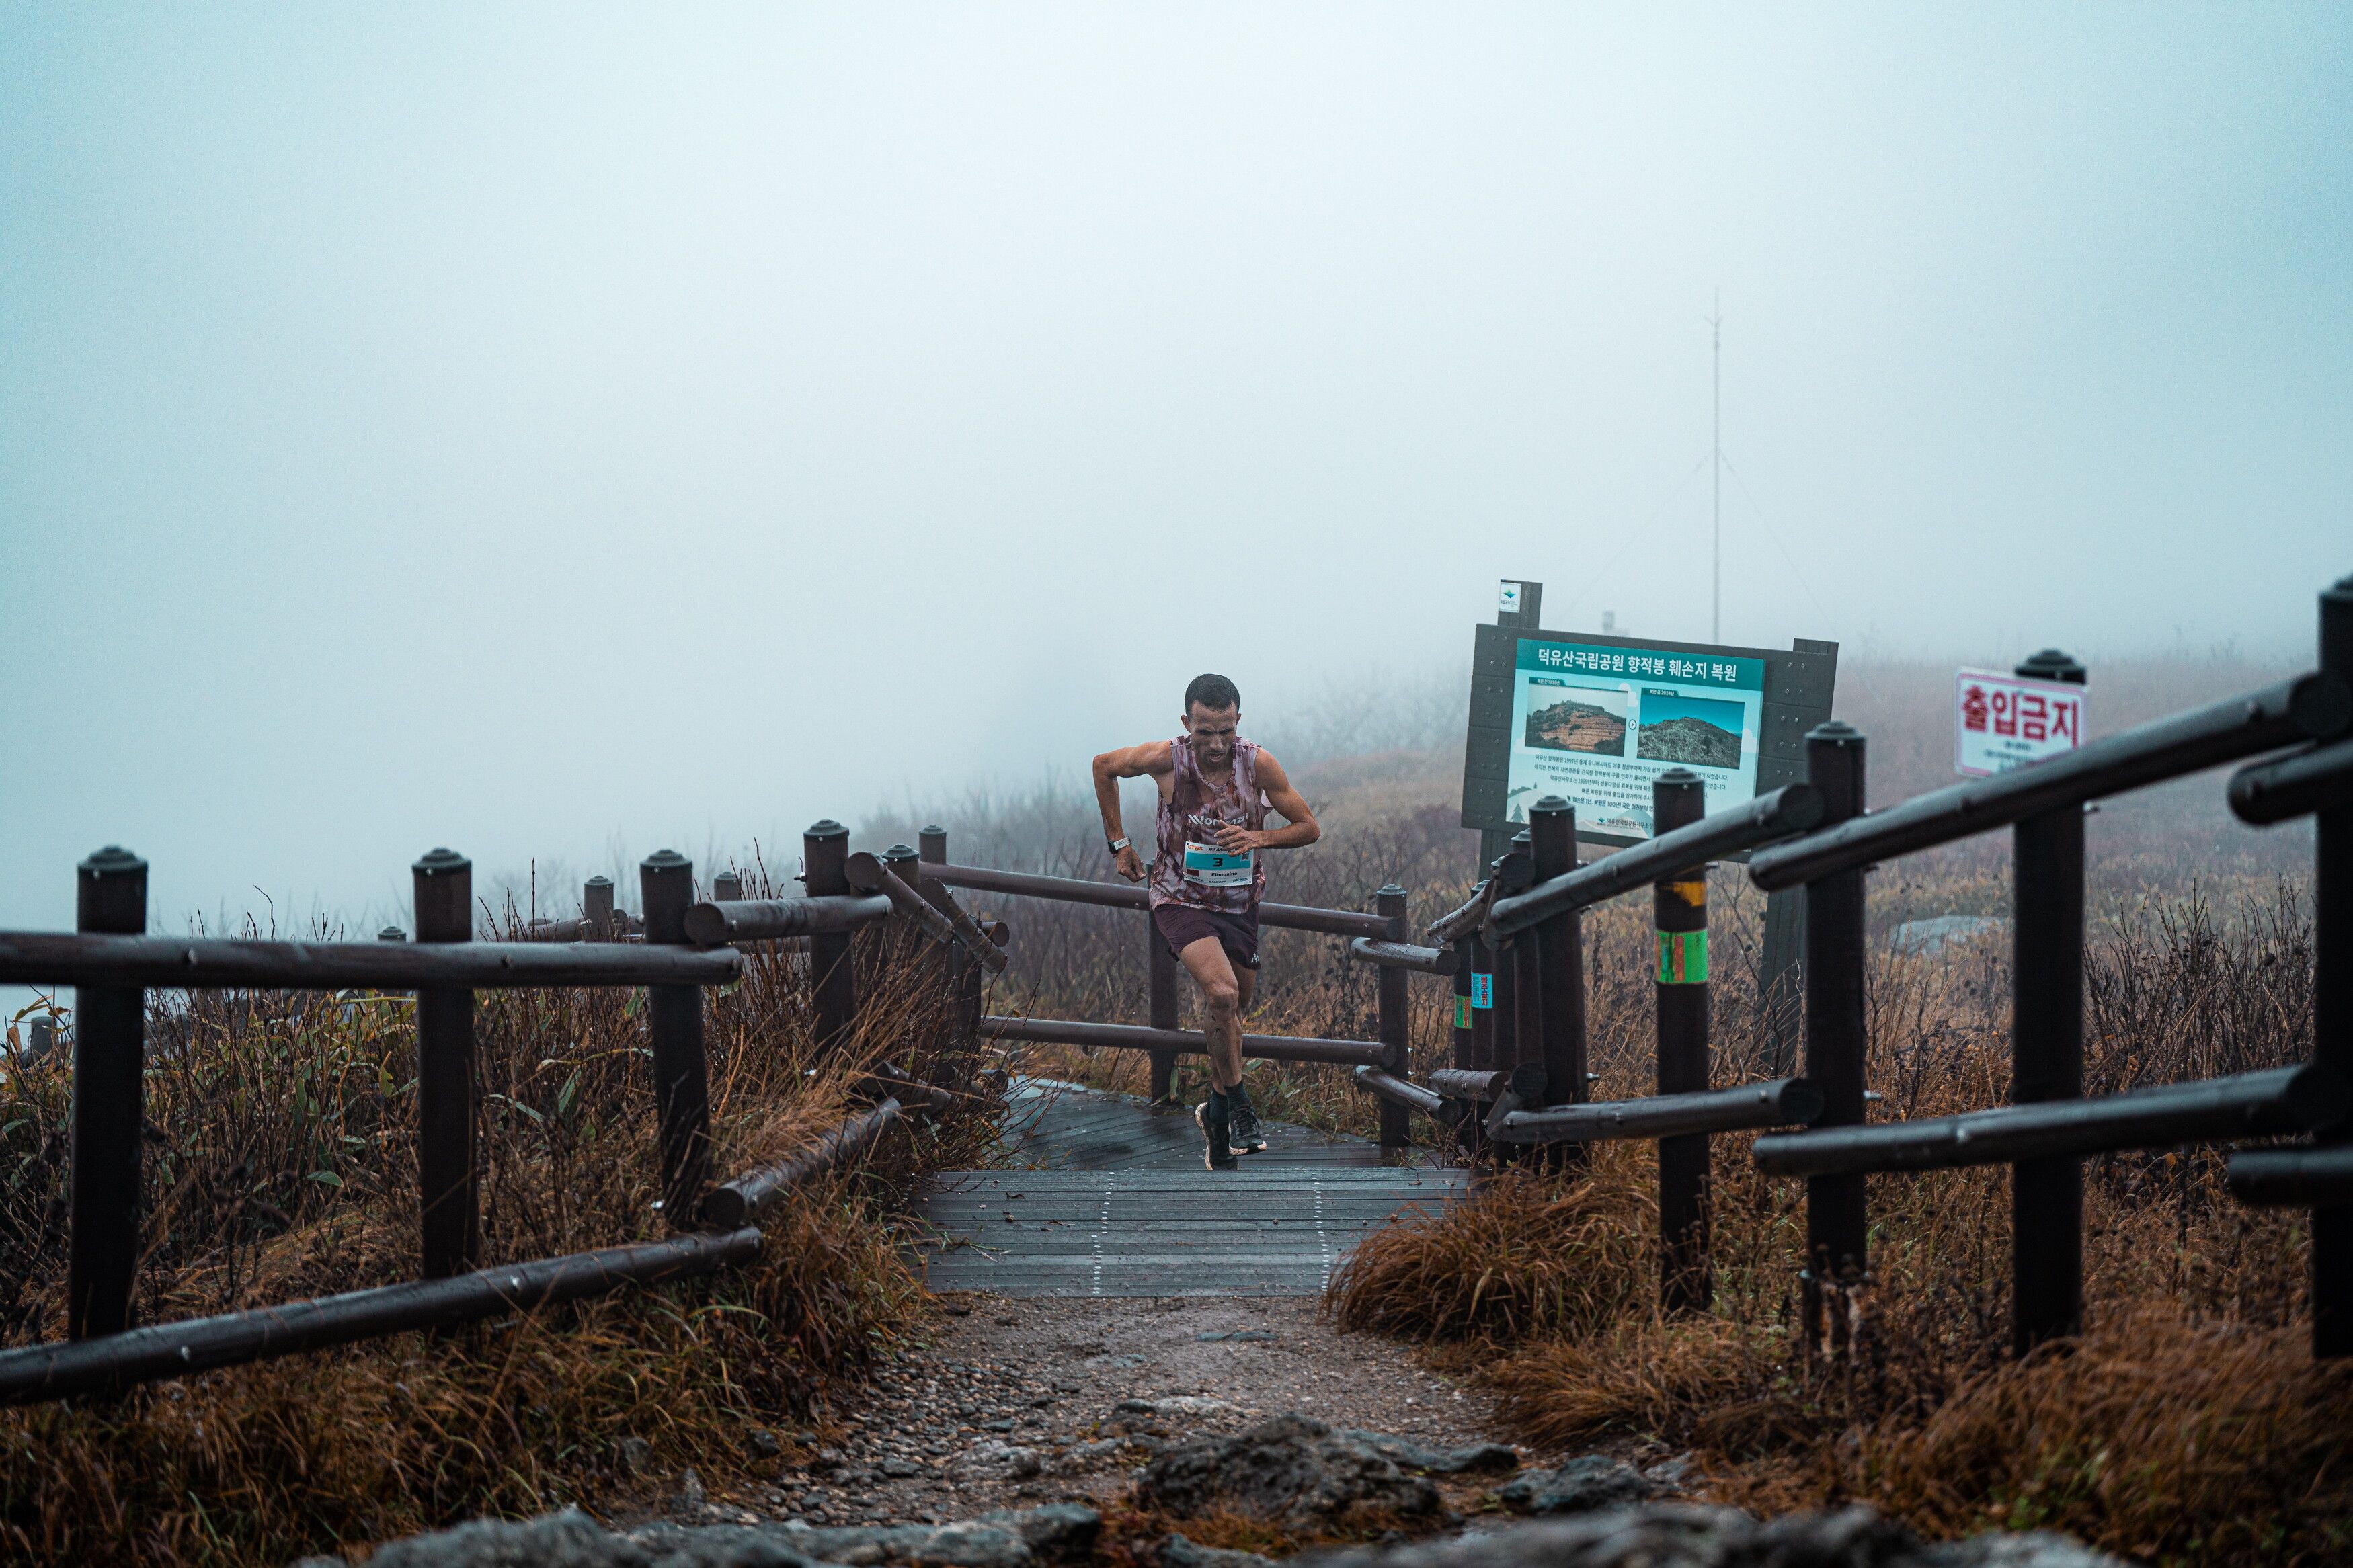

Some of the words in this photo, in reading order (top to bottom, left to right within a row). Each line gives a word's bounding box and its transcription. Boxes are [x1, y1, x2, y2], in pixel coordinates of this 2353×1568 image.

[1538, 649, 1624, 671] 덕유산국립공원
[1628, 656, 1665, 675] 향적봉
[1669, 659, 1707, 679] 훼손지
[1711, 663, 1737, 682] 복원
[1962, 684, 2079, 749] 출입금지
[1550, 774, 1577, 783] 덕유산사무소는
[1213, 857, 1223, 867] 3
